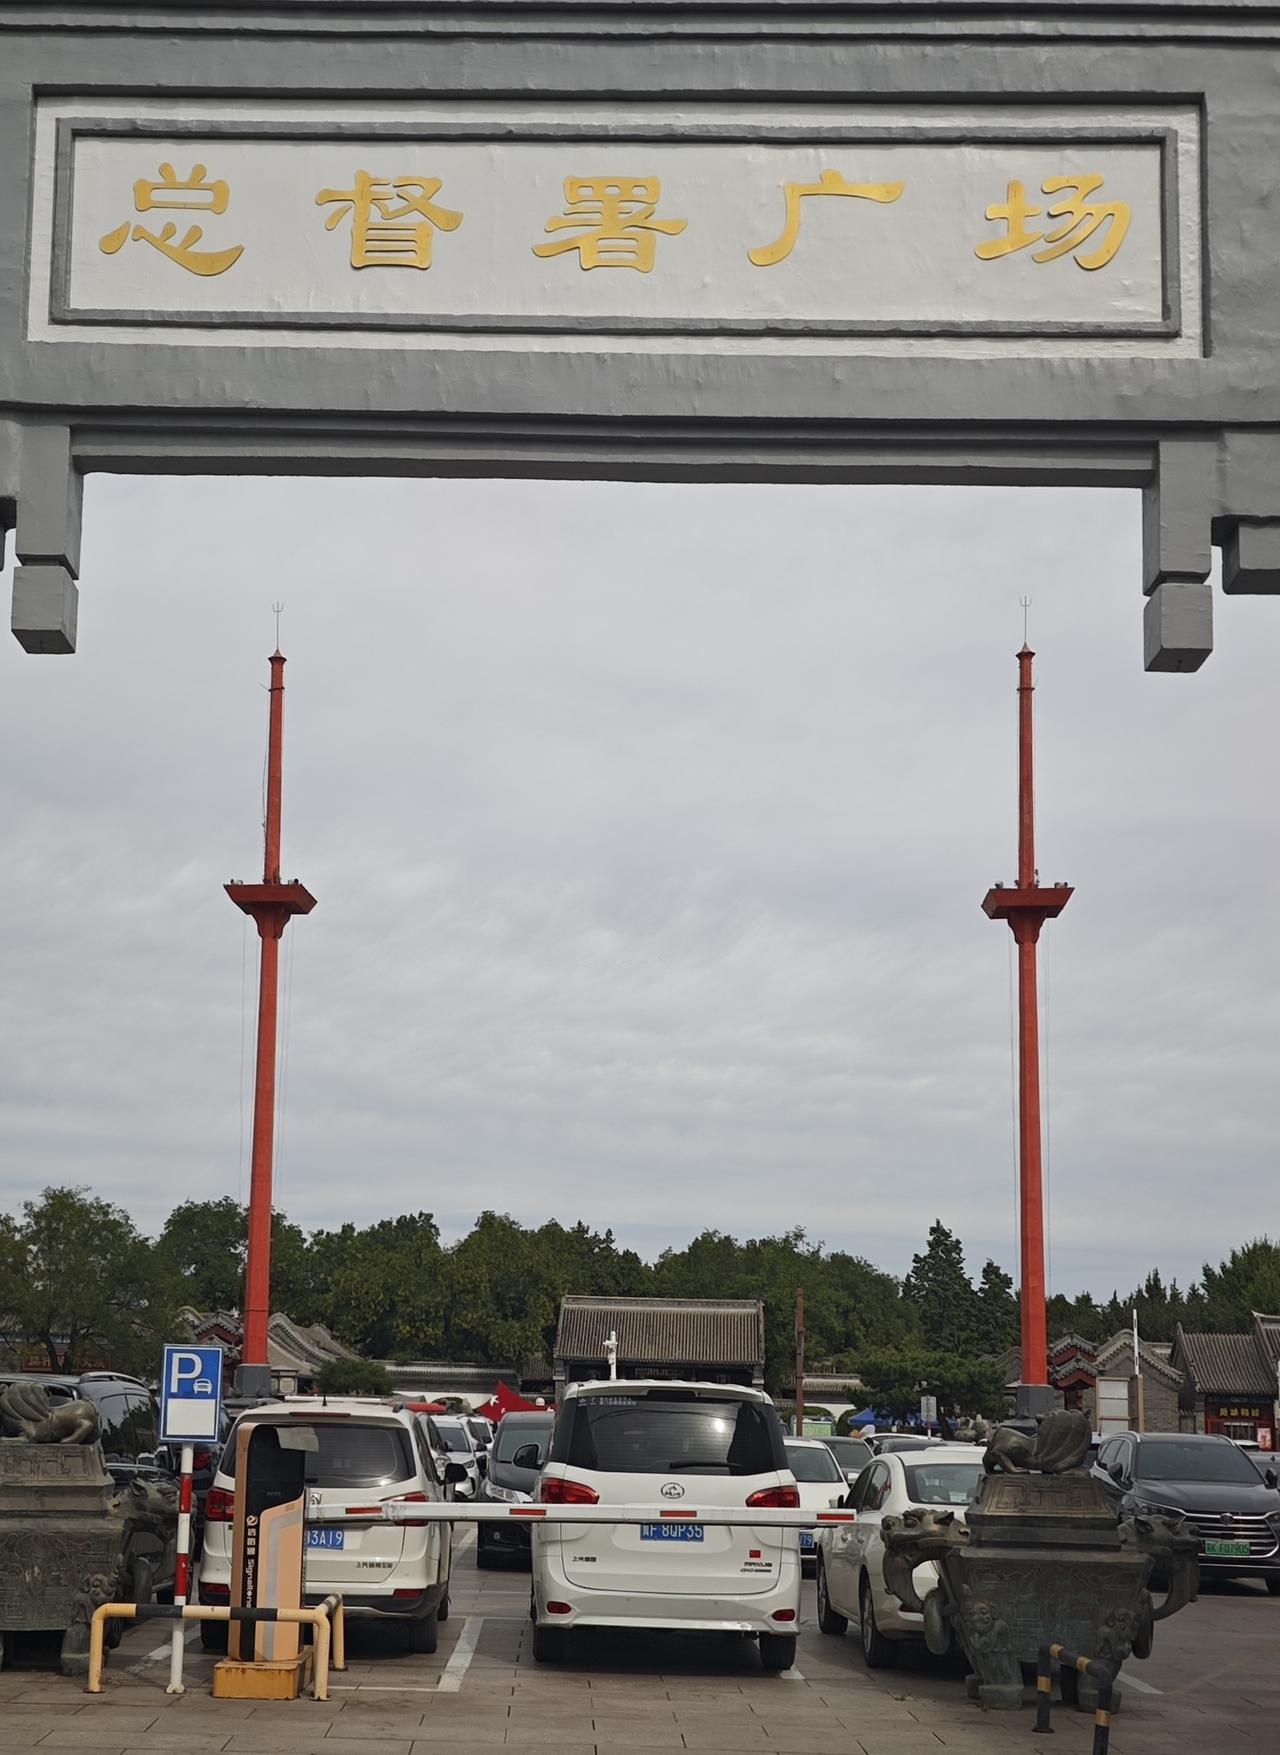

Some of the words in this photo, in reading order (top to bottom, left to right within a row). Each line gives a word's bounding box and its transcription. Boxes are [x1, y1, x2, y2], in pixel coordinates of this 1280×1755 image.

[99, 162, 1132, 277] 总督署广场
[171, 1352, 203, 1393] P
